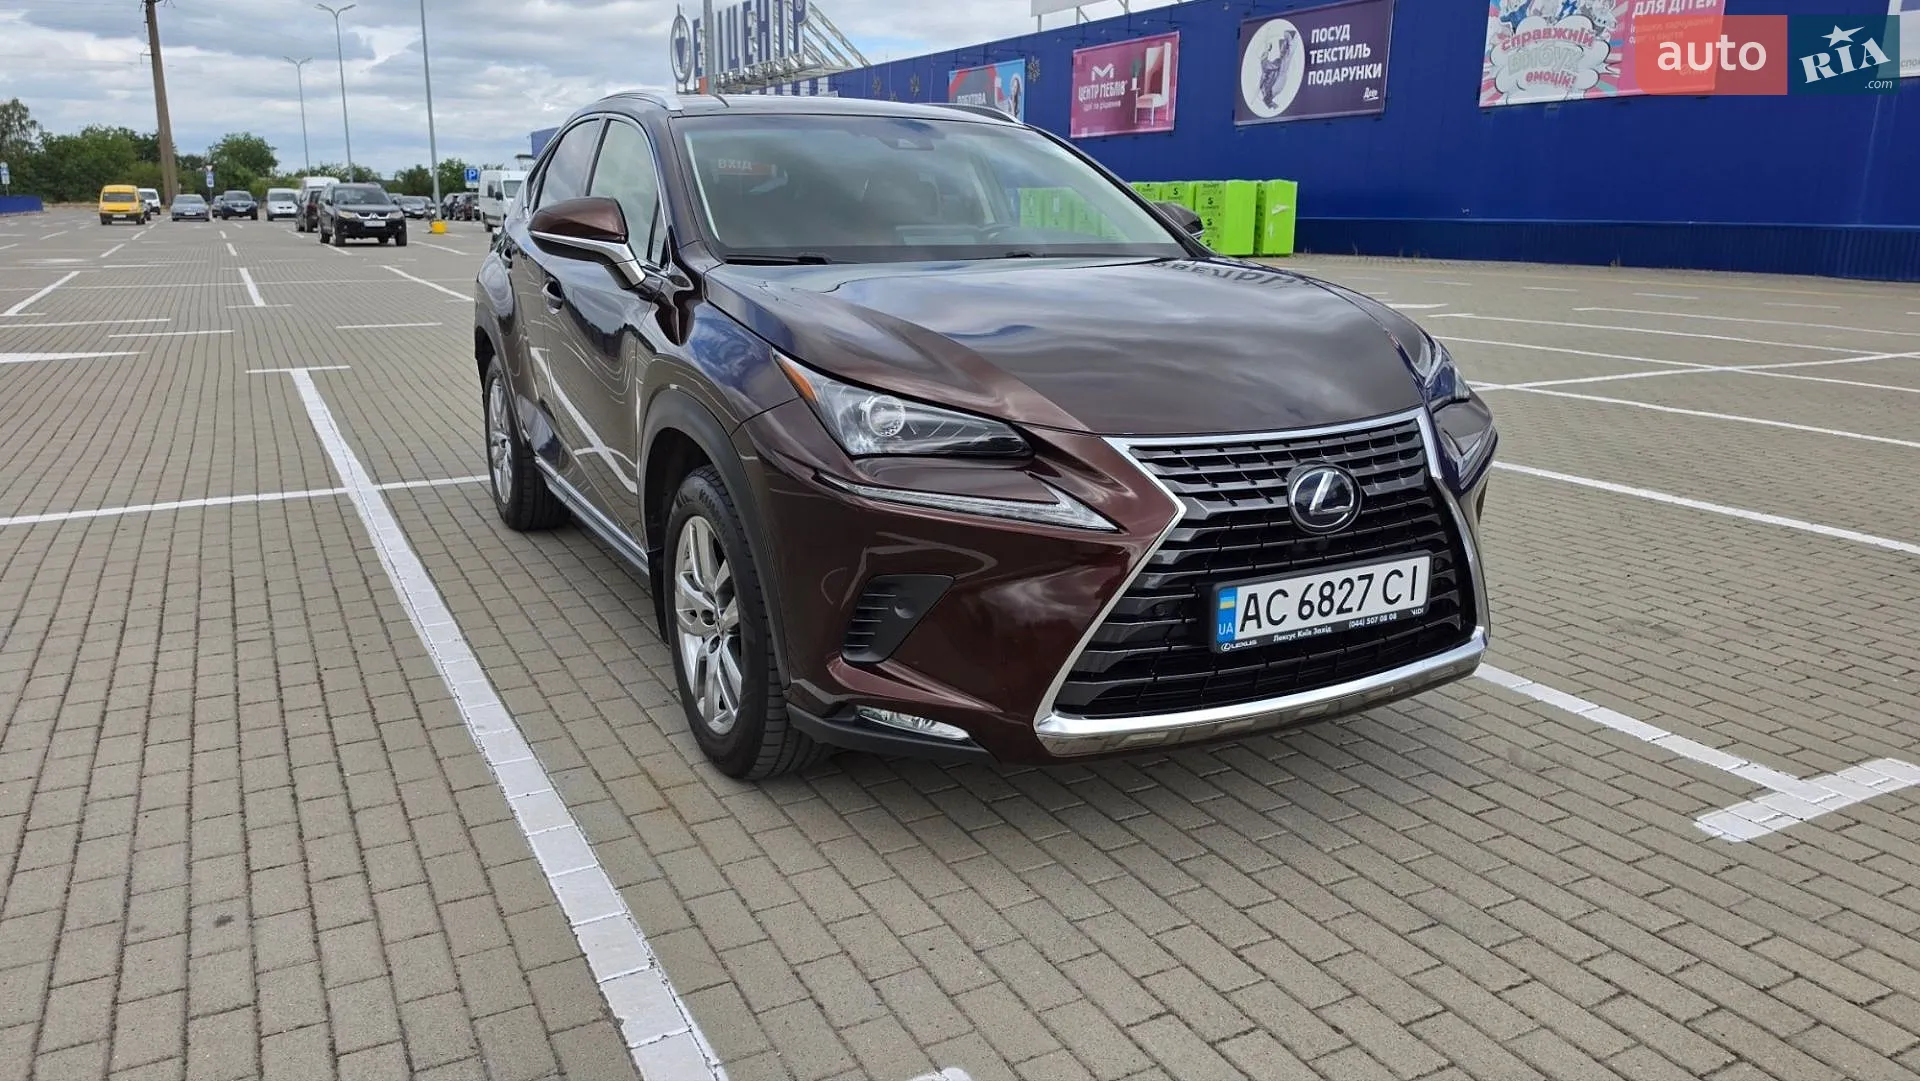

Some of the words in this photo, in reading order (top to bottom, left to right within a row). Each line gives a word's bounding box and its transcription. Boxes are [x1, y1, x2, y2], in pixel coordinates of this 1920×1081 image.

[1632, 1, 1666, 18] ДЛЯ
[1311, 24, 1350, 43] ПОСУД
[1310, 43, 1371, 64] ТЕКСТИЛЬ
[1307, 63, 1382, 86] ПОДАРУНКИ
[1079, 84, 1099, 102] ЦЕНТР
[1239, 588, 1289, 632] AC
[1298, 573, 1374, 620] 6827
[1383, 565, 1418, 605] CI
[1218, 622, 1234, 636] UA
[1366, 616, 1378, 625] 507
